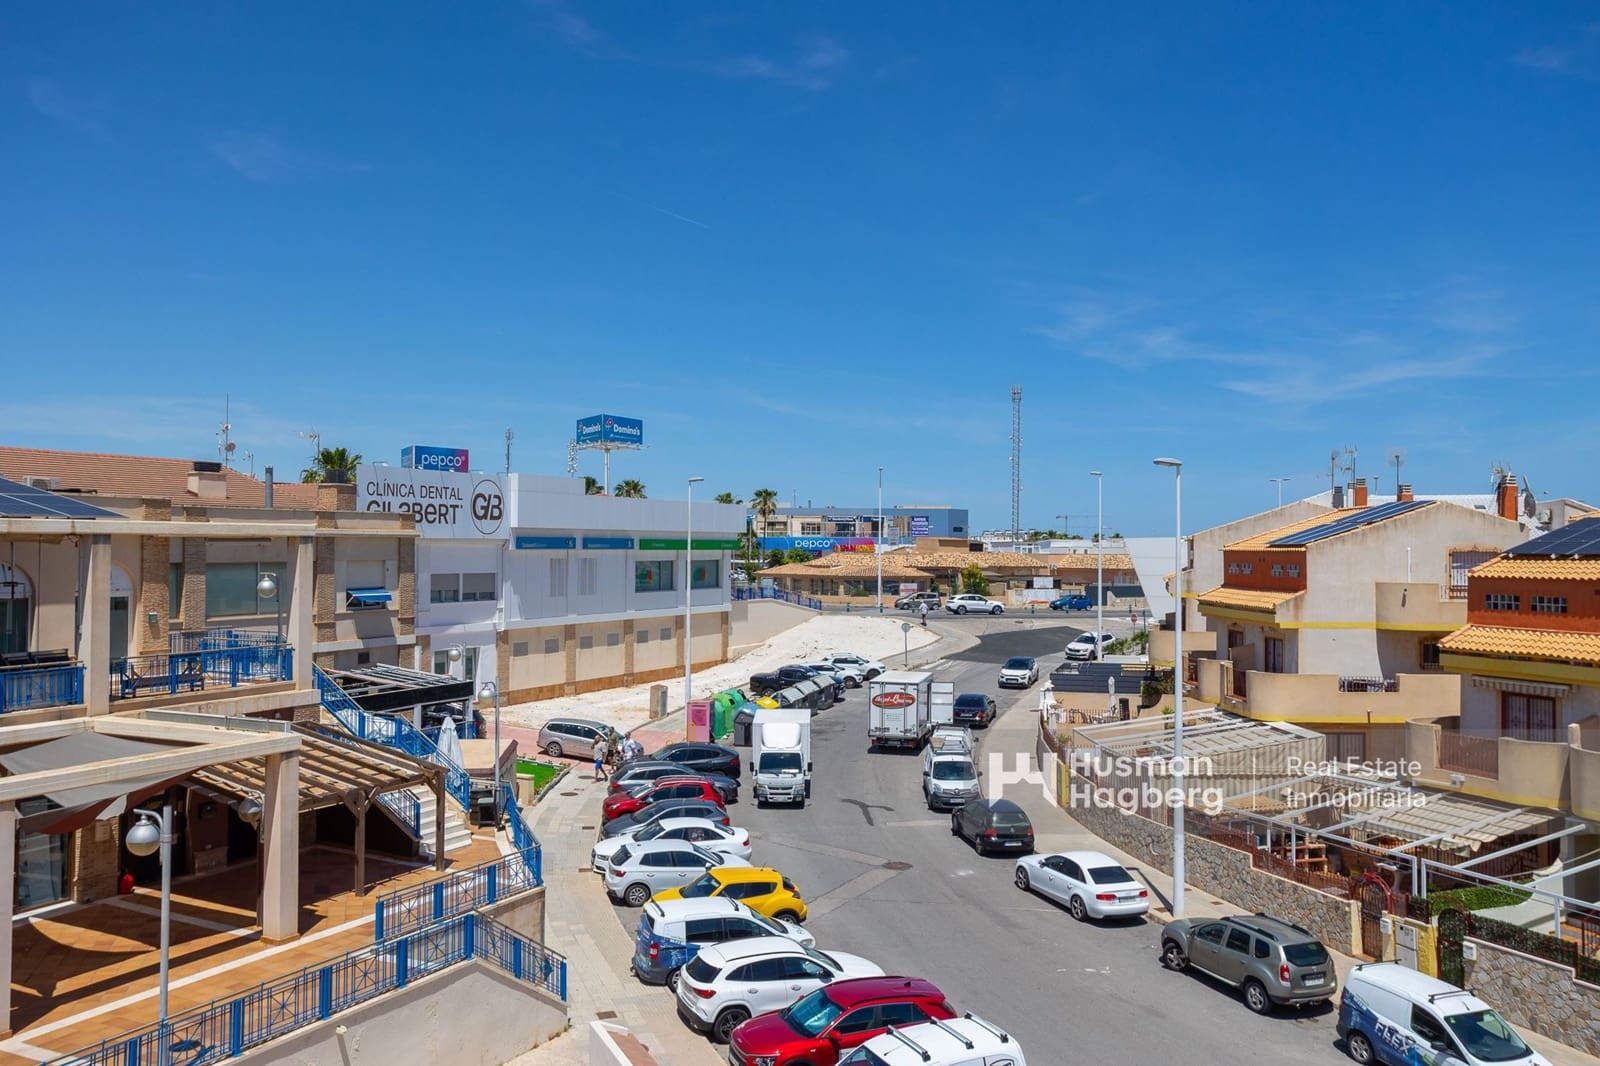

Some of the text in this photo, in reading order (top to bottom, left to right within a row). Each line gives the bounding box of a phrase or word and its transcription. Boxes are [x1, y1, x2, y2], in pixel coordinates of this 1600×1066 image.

[421, 453, 462, 467] pepco
[366, 478, 463, 500] CLÍNICA DENTAL
